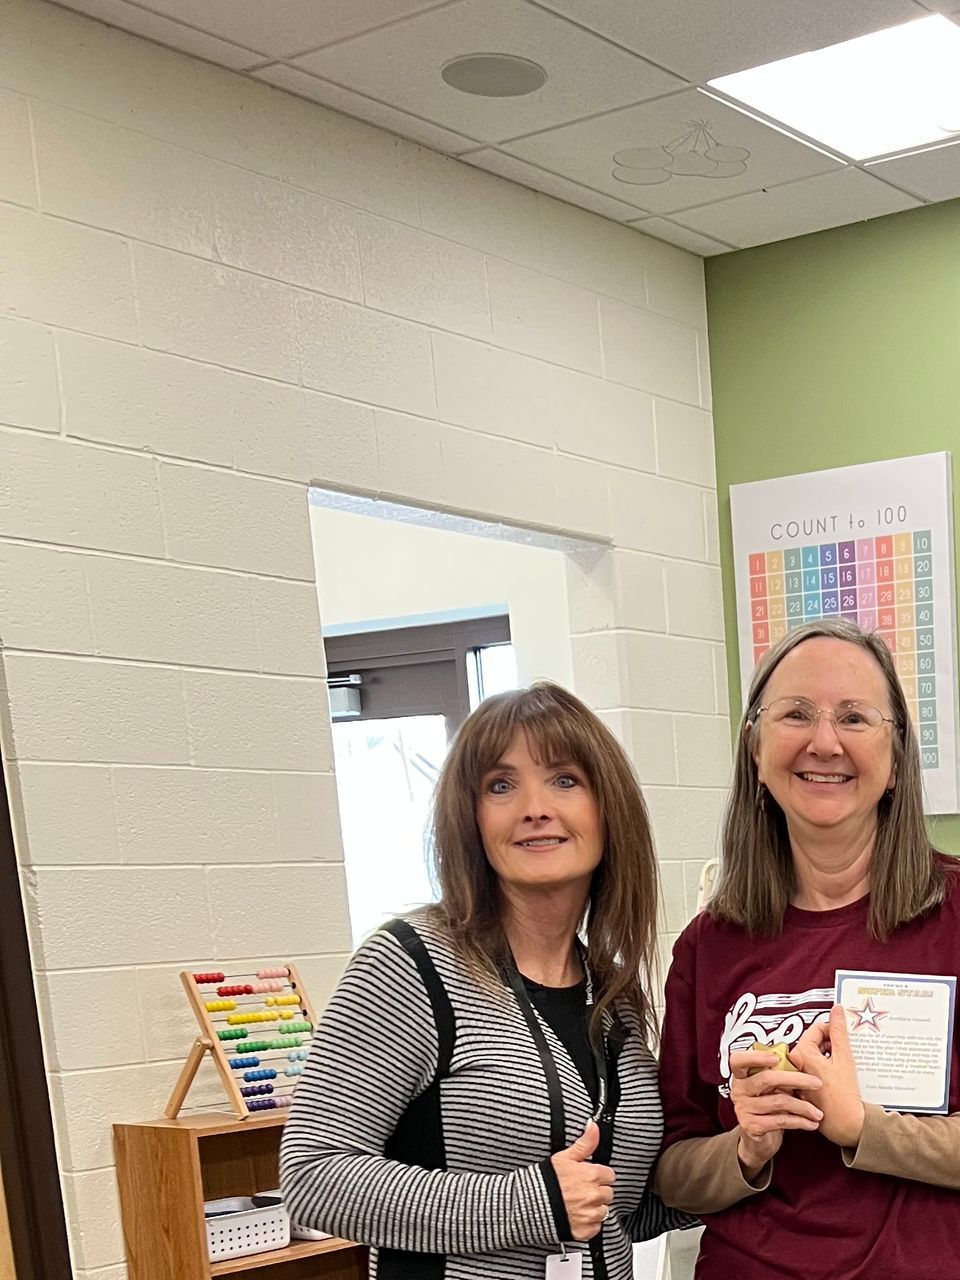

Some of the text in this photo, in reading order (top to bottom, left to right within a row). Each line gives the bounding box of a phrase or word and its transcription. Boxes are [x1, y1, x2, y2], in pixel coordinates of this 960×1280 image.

[771, 505, 907, 540] COUNT to 100
[756, 560, 760, 571] 1
[772, 558, 778, 569] 2
[790, 556, 795, 566] 3
[808, 554, 813, 563] 4
[825, 551, 832, 561] 5
[843, 548, 850, 559] 6
[863, 545, 868, 555] 7
[881, 543, 887, 554] 8
[917, 538, 928, 549] 10
[755, 582, 762, 593] 11
[770, 580, 781, 591] 12
[789, 577, 799, 589] 13
[806, 575, 816, 586] 14
[824, 572, 835, 584] 15
[842, 570, 853, 582] 16
[861, 568, 871, 580] 17
[880, 566, 890, 577] 18
[917, 560, 930, 572] 20
[755, 606, 764, 617] 21
[790, 601, 800, 613] 23
[807, 600, 819, 611] 24
[824, 597, 837, 609] 25
[842, 595, 855, 607] 26
[861, 592, 873, 605] 27
[880, 590, 892, 602] 28
[918, 586, 930, 598] 30
[881, 614, 892, 625] 38
[919, 609, 930, 621] 40
[920, 634, 932, 646] 50
[920, 658, 932, 669] 60
[920, 682, 932, 693] 70
[921, 706, 933, 718] 80
[922, 729, 934, 741] 90
